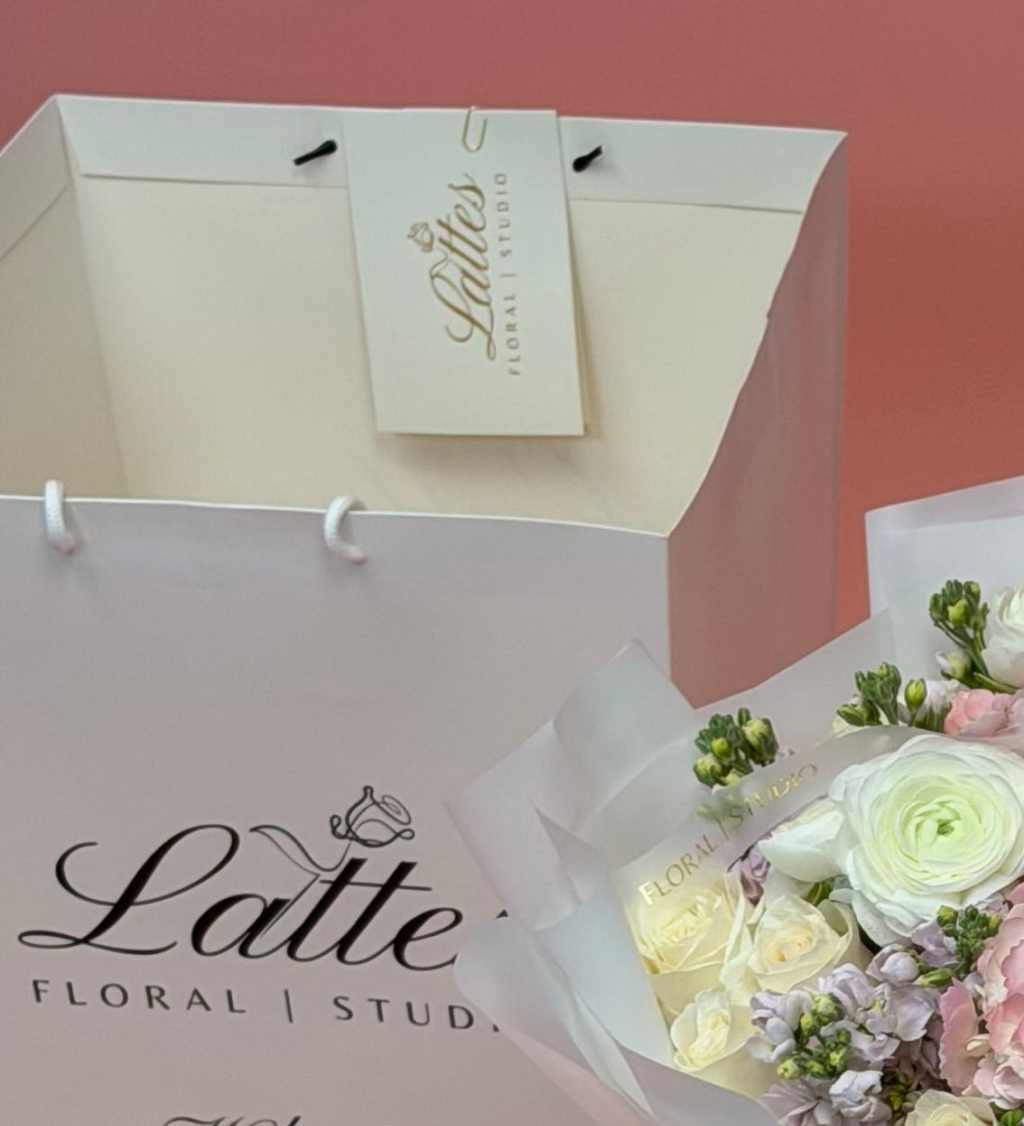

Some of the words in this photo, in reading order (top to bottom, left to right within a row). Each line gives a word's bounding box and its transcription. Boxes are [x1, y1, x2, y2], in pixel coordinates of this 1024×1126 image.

[494, 173, 513, 258] STUDIO
[431, 173, 497, 361] Lattes
[502, 293, 521, 376] FLORAL
[17, 822, 508, 971] Latte
[637, 834, 717, 906] FLORAL
[32, 979, 247, 1014] FLORAL
[333, 995, 501, 1033] STUD
